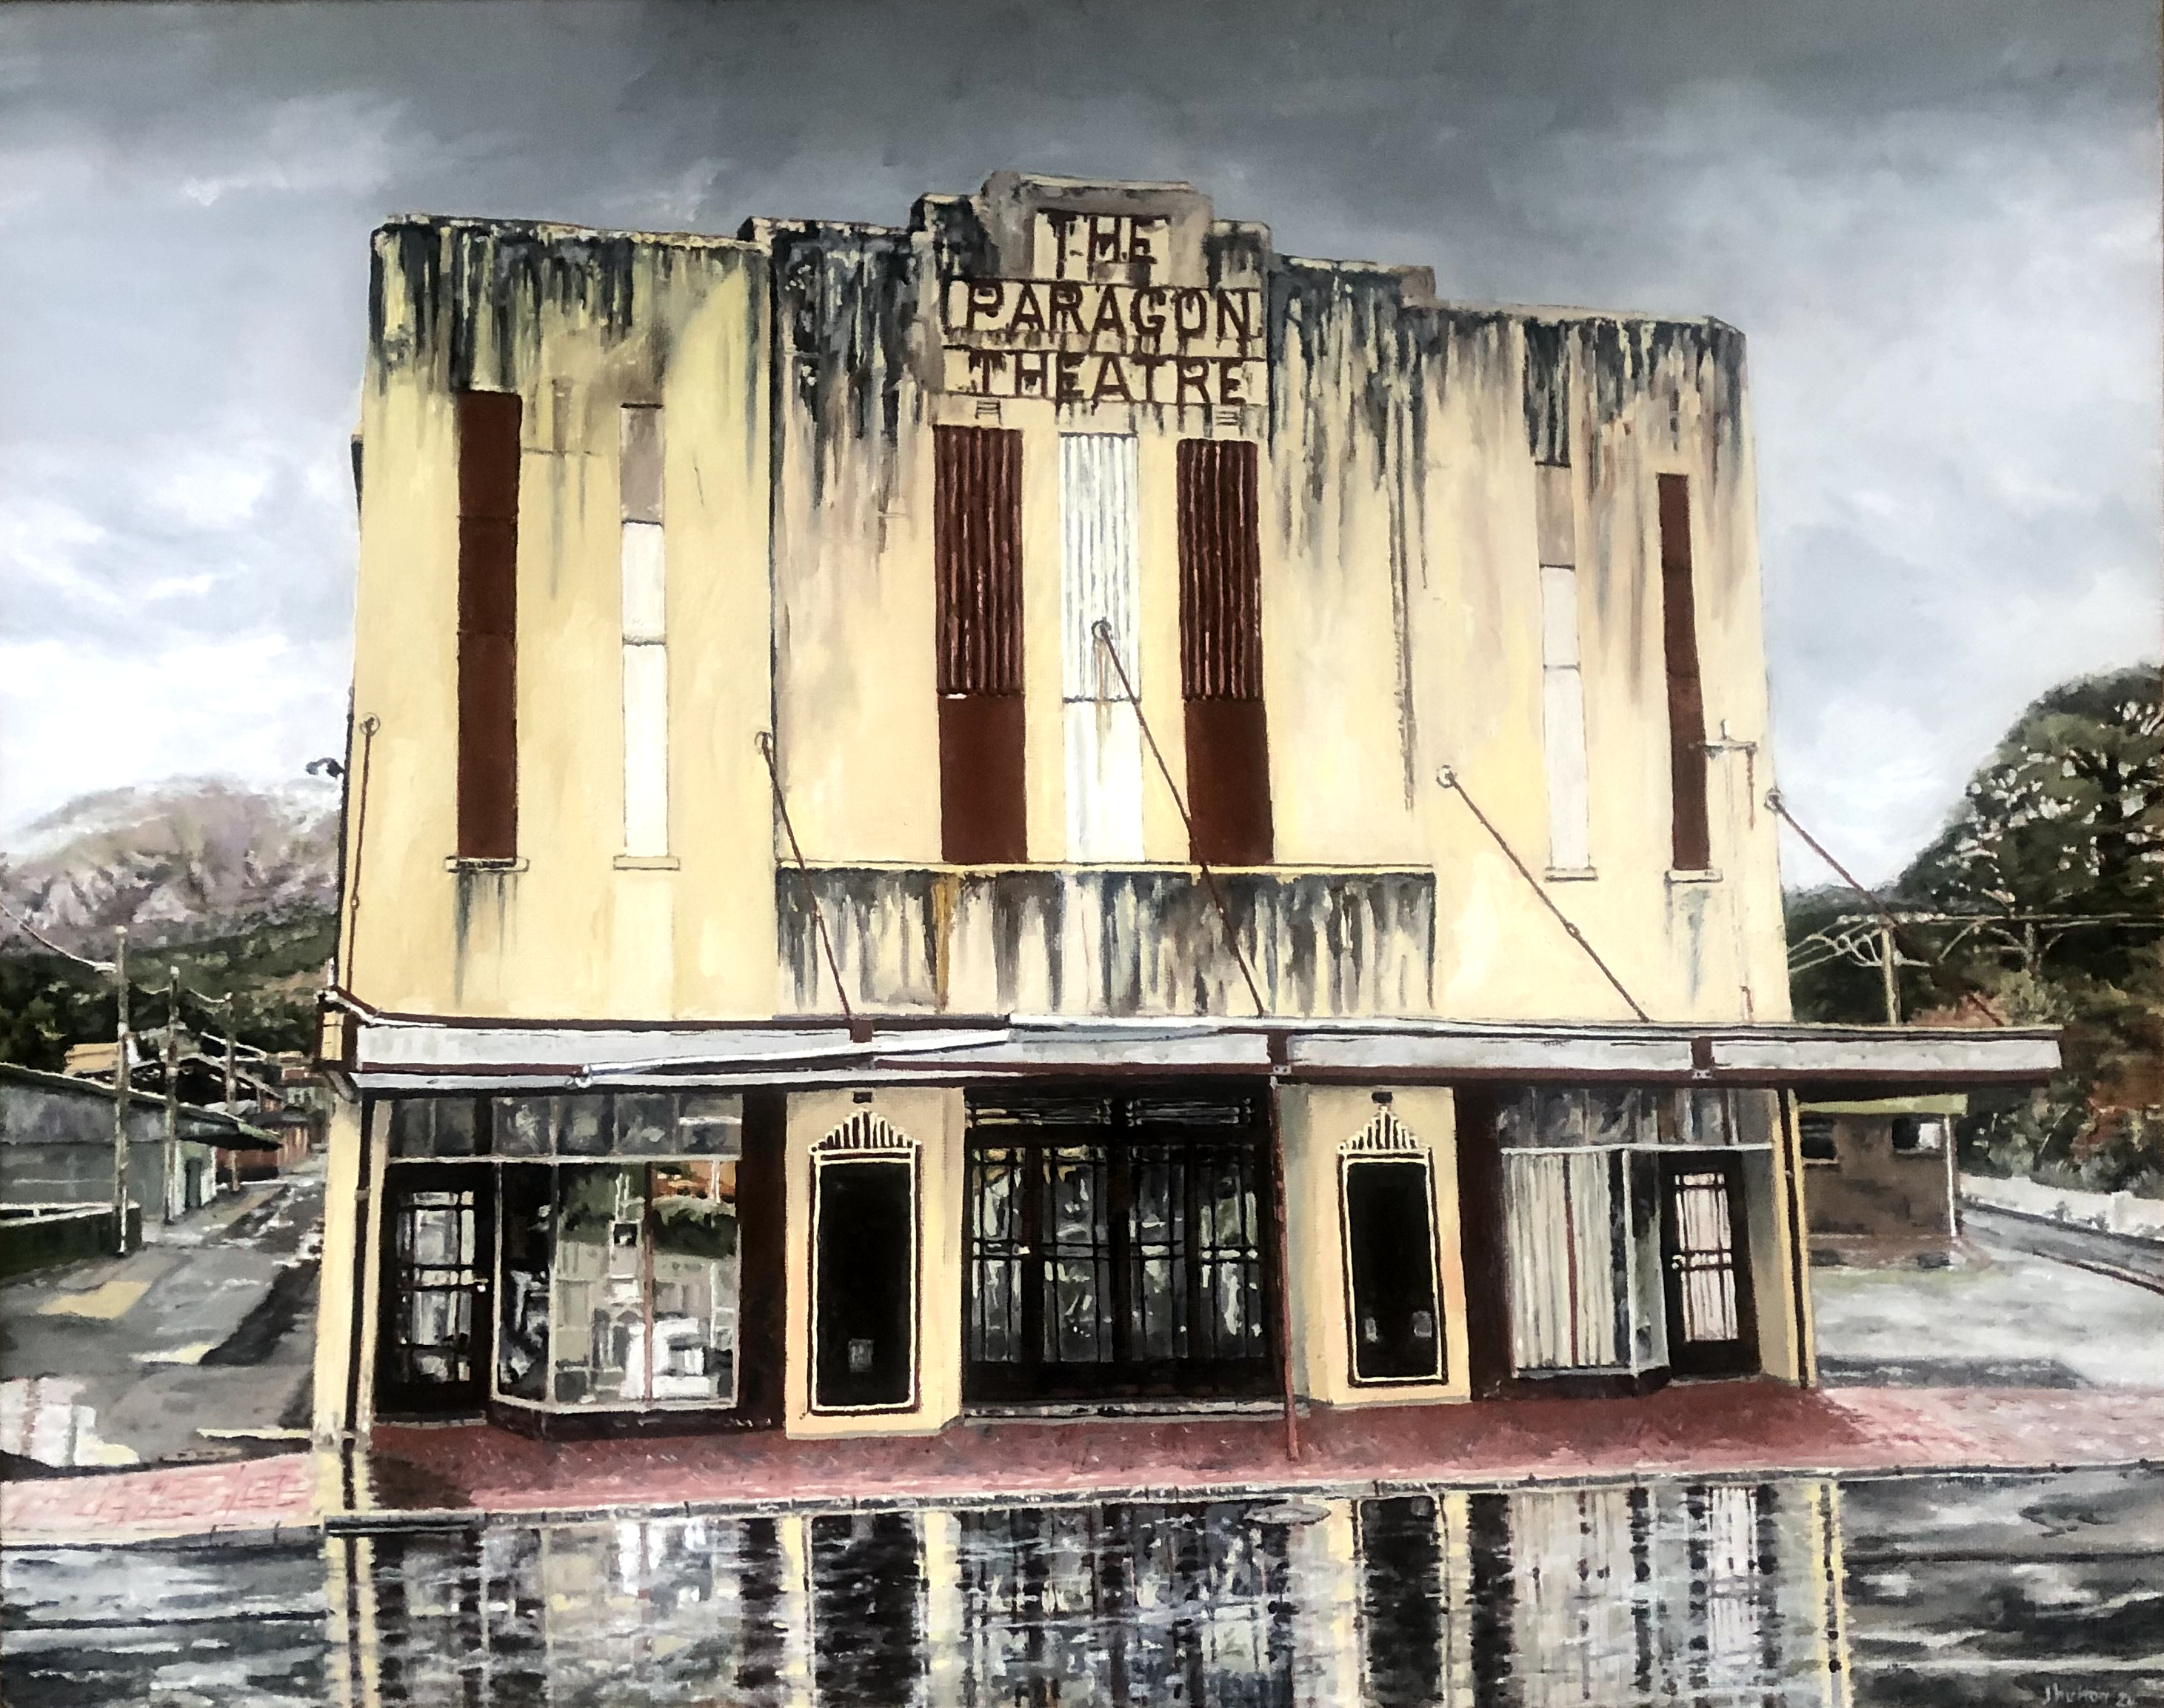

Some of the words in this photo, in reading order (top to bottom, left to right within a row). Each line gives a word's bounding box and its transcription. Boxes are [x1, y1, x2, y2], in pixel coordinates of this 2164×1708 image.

[1048, 210, 1169, 271] THE
[966, 280, 1253, 348] PARAGON
[969, 350, 1249, 407] THEATRE
